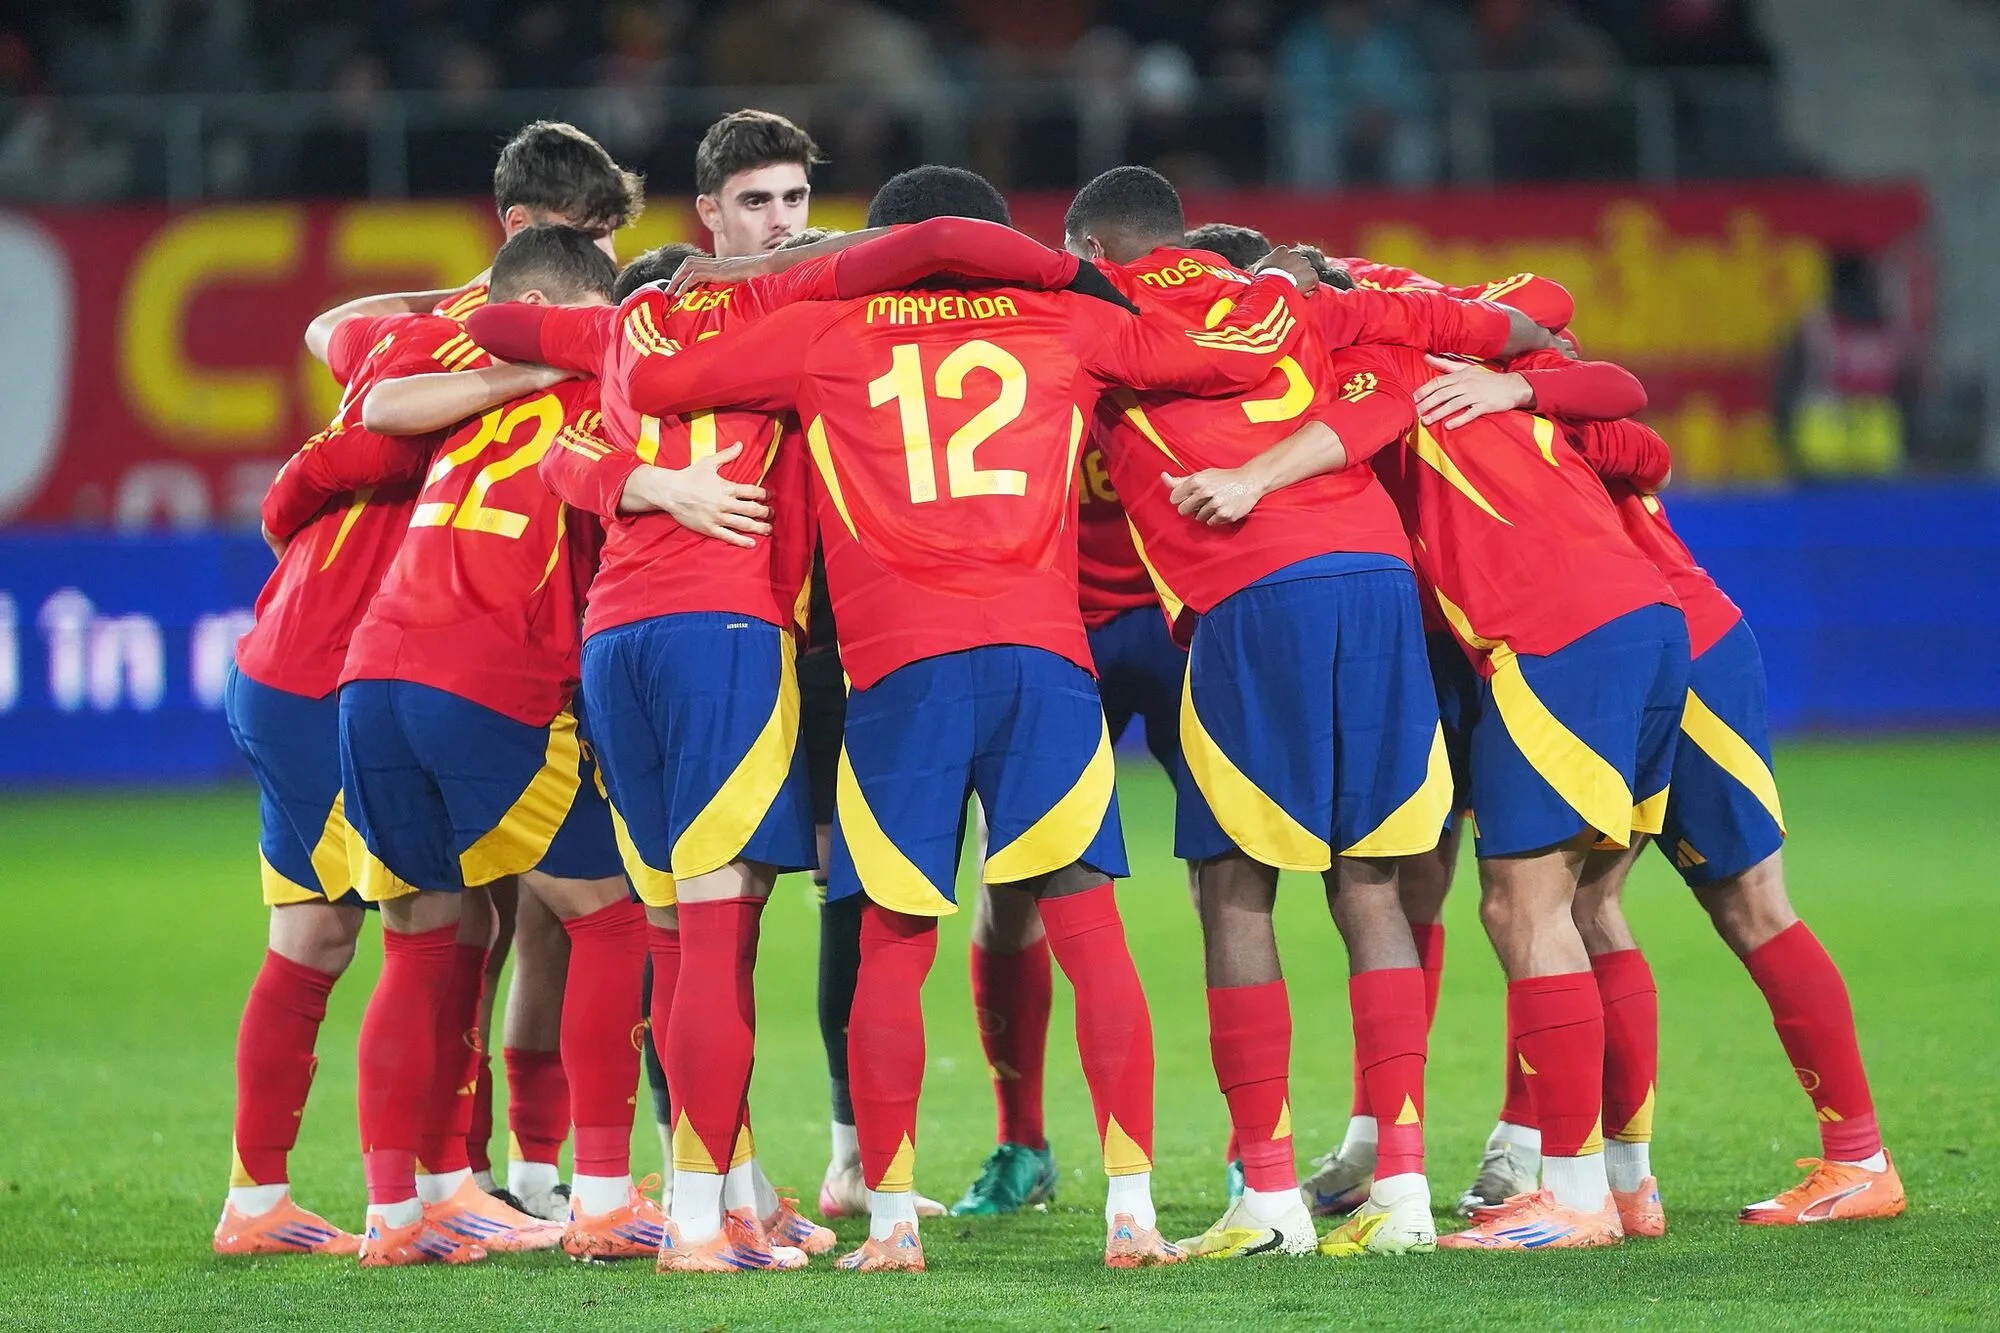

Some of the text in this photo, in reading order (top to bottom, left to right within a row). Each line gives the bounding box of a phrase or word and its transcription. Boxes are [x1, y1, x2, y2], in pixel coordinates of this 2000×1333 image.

[866, 296, 1018, 325] MAYENDA
[409, 393, 564, 540] 22
[868, 339, 1028, 504] 12
